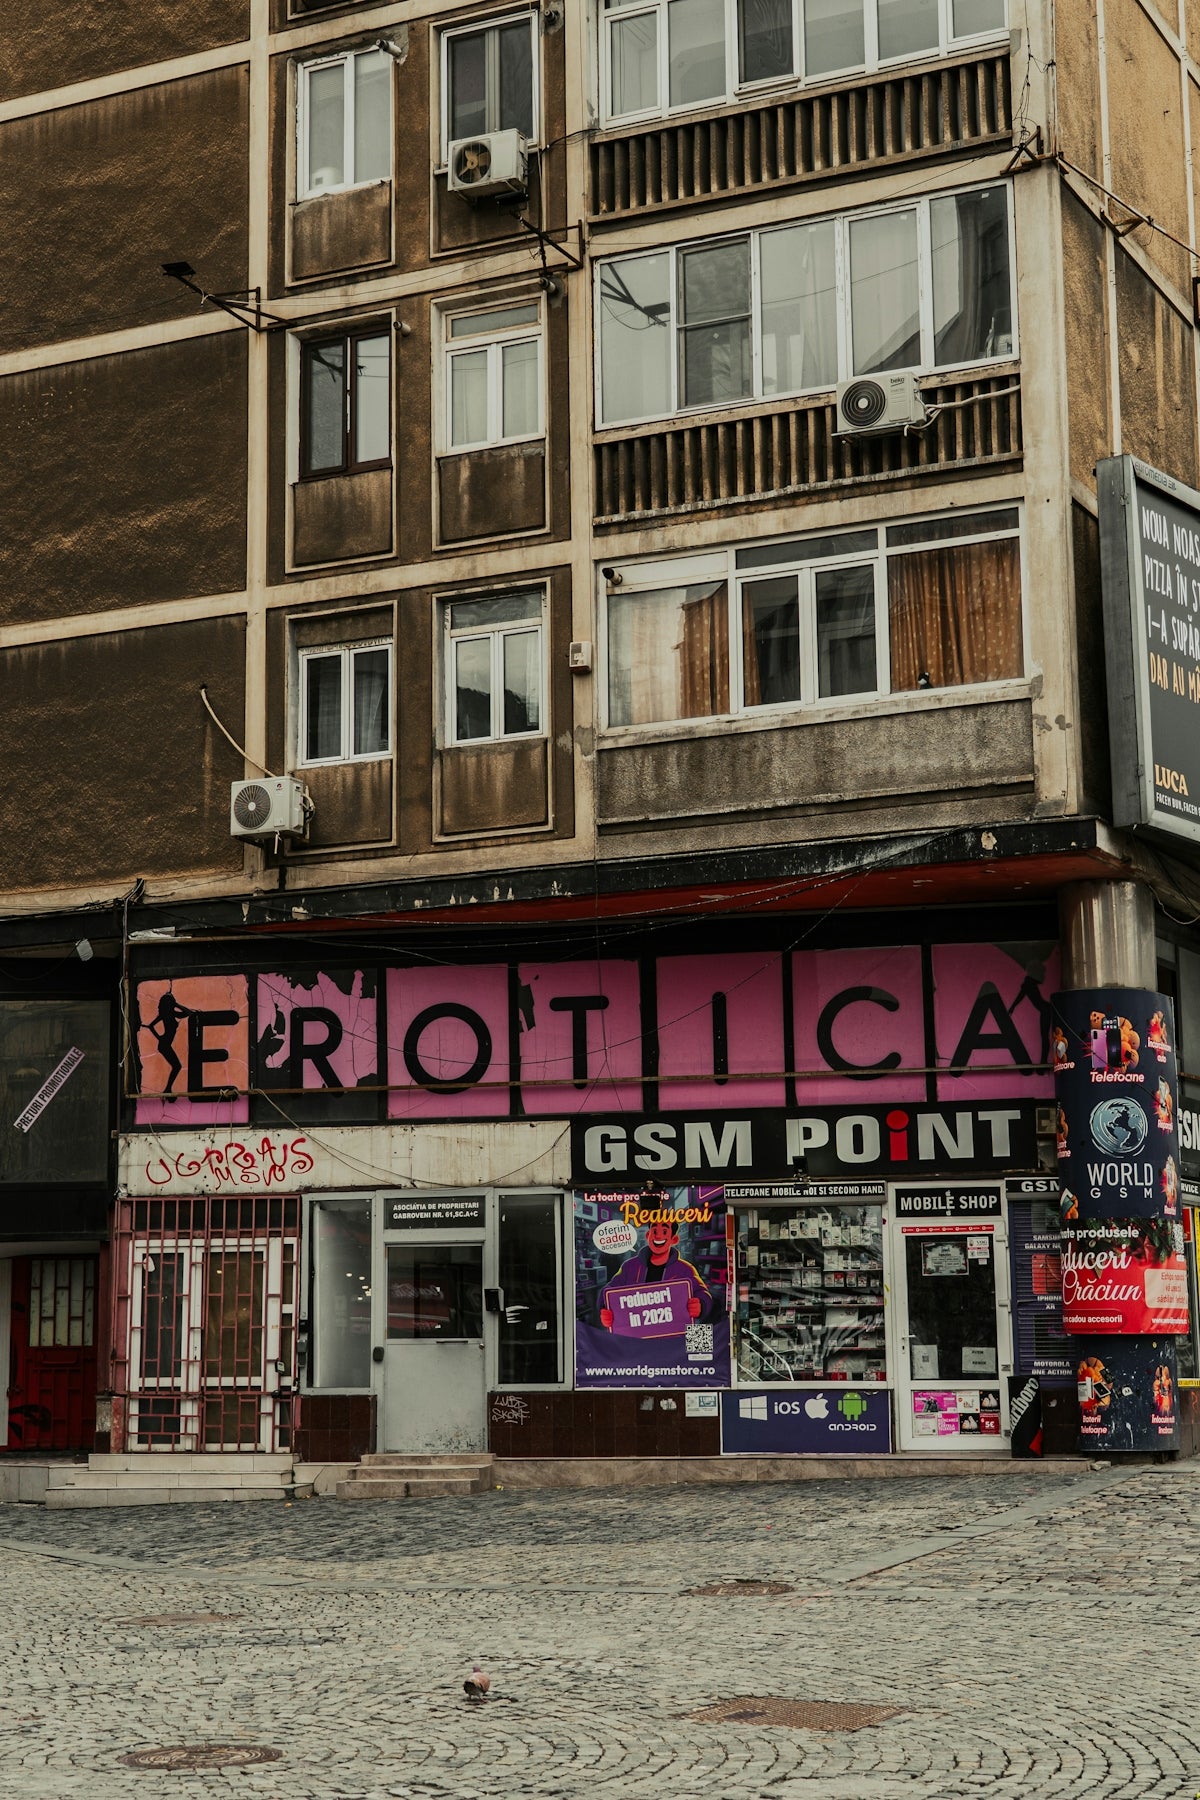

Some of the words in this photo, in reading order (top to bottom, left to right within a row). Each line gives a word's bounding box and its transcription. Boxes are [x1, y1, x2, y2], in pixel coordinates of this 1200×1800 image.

[1142, 506, 1170, 551] NOUA
[1144, 554, 1173, 600] PIZZA
[1175, 563, 1188, 607] ÎN
[1149, 651, 1169, 691] DAR
[1173, 661, 1185, 697] AU
[1154, 763, 1189, 797] LUCA
[188, 985, 1035, 1102] EROTICA
[1090, 1071, 1145, 1083] Telefoane
[16, 1099, 45, 1131] PRETURI
[38, 1048, 83, 1103] PROMOTIONALE
[584, 1120, 753, 1173] GSM
[1086, 1162, 1154, 1186] WORLD
[584, 1193, 597, 1202] La
[597, 1193, 624, 1202] toate
[819, 1186, 828, 1195] SI
[828, 1185, 860, 1195] SECOND
[437, 1202, 479, 1210] PROPRIETARI
[900, 1196, 956, 1211] MOBILE
[960, 1194, 998, 1209] SHOP
[393, 1212, 431, 1220] GABROVENI
[432, 1211, 444, 1219] NR.
[598, 1224, 630, 1237] oferim
[1077, 1226, 1140, 1241] produsele
[599, 1232, 632, 1245] cadou
[601, 1240, 633, 1251] accesorii
[1062, 1268, 1142, 1305] Crăciun
[619, 1287, 672, 1309] reduceri
[629, 1311, 641, 1328] in
[642, 1307, 673, 1326] 2026
[1068, 1314, 1087, 1323] cadou
[1087, 1314, 1123, 1323] accesorii
[585, 1364, 716, 1379] www.worldgsmstore.ro
[774, 1401, 801, 1415] iOS
[984, 1420, 995, 1428] 5€
